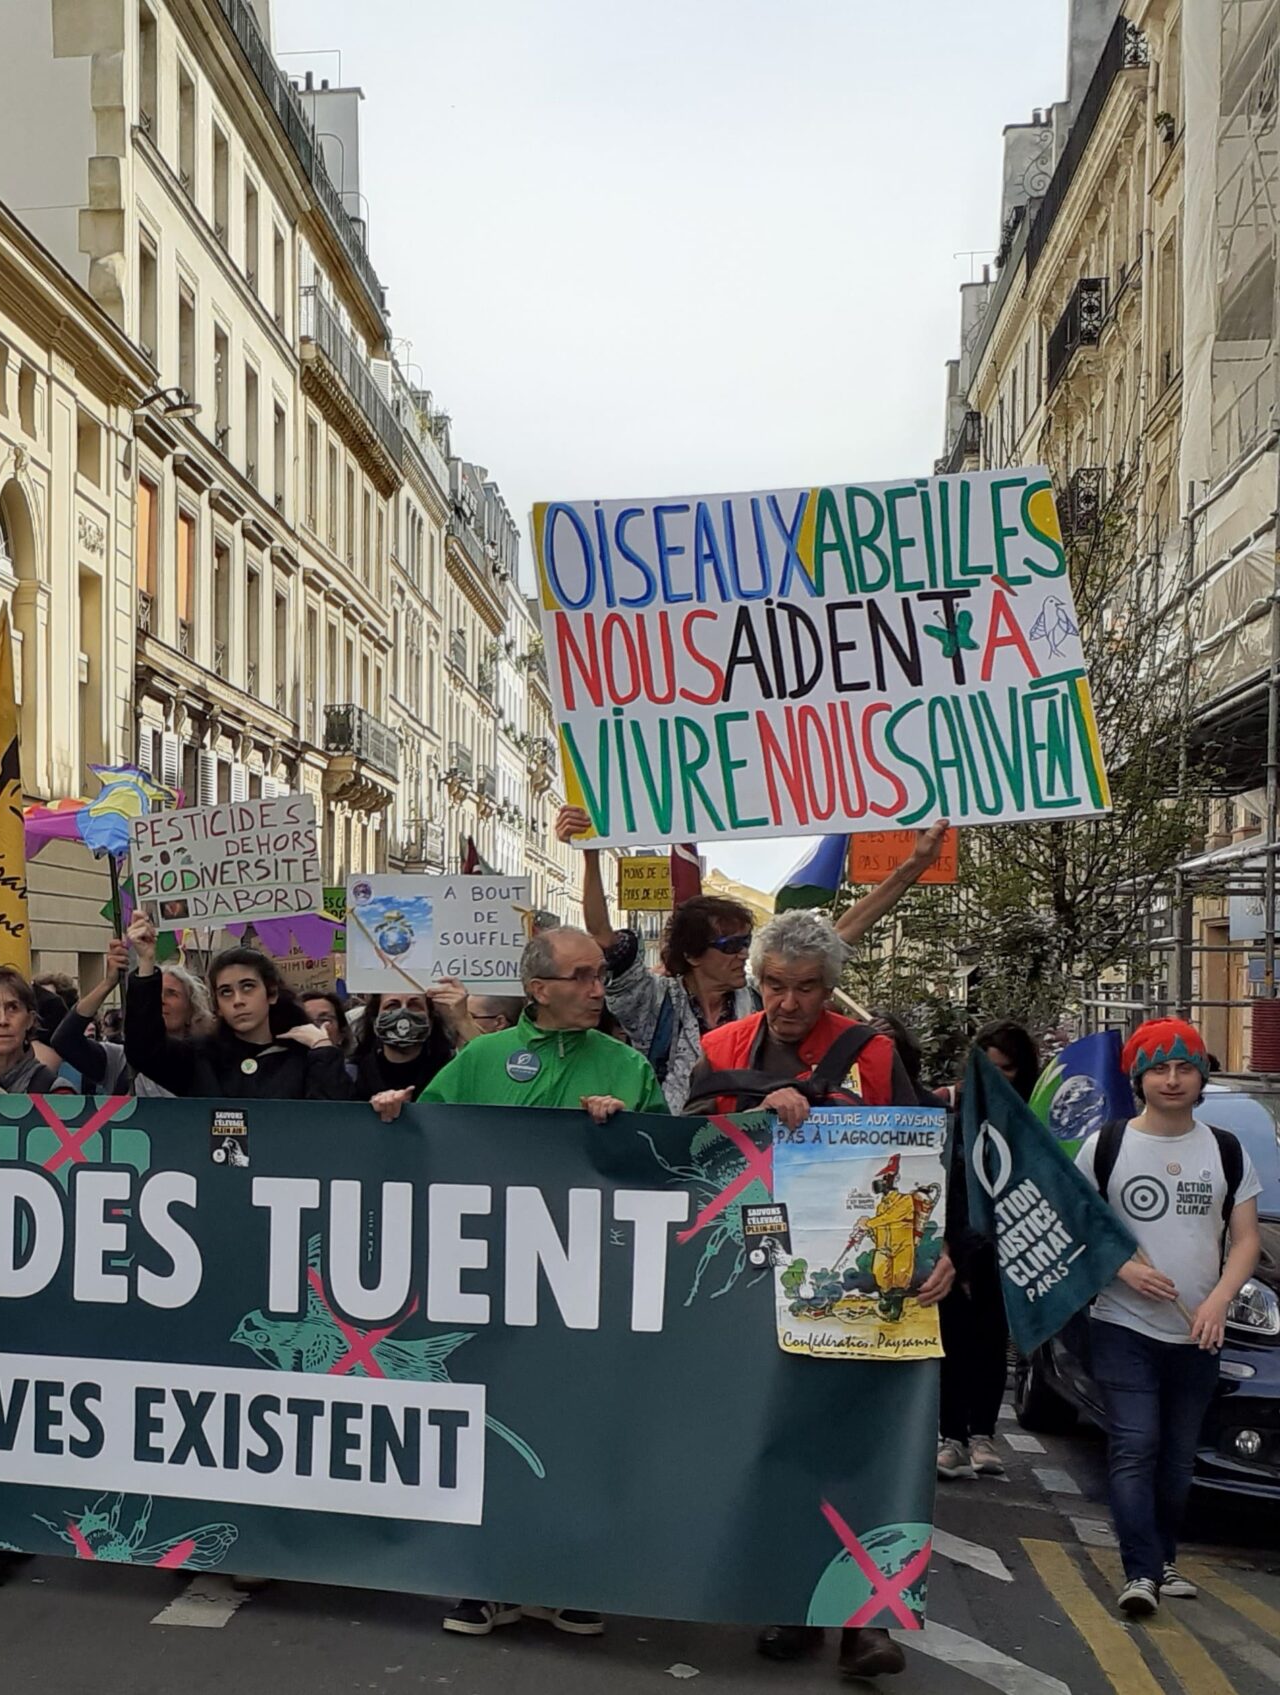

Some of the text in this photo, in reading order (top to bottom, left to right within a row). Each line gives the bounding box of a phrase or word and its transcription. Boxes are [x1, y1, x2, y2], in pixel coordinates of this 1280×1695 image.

[545, 477, 1066, 610] OISEAUX ABEILLES
[555, 574, 1042, 711] NOUS AIDENT À
[560, 707, 769, 837] VIVRE
[756, 701, 909, 825] NOUS
[135, 803, 303, 850] PESTICIDES
[225, 830, 317, 856] DEHORS
[137, 853, 321, 896] BIODIVERSITÉ
[192, 889, 313, 917] D'ABORD
[444, 886, 526, 902] A BOUT
[474, 911, 498, 924] DE
[440, 931, 524, 947] SOUFFLE
[430, 954, 521, 978] AGISSON
[867, 1114, 890, 1126] AUX
[895, 1114, 946, 1128] PAYSANS
[777, 1131, 805, 1145] PAS
[828, 1131, 934, 1147] L'AGROCHIMIE
[1176, 1180, 1213, 1193] ACTION
[1176, 1193, 1213, 1205] JUSTICE
[995, 1178, 1042, 1235] TION
[1176, 1204, 1211, 1216] CLIMAT
[998, 1199, 1058, 1267] JUSTICE
[252, 1177, 690, 1332] TUENT
[1005, 1220, 1074, 1287] CLIMAT
[1026, 1261, 1069, 1303] PARIS
[877, 1332, 939, 1354] Paysanne
[133, 1386, 470, 1489] EXISTENT
